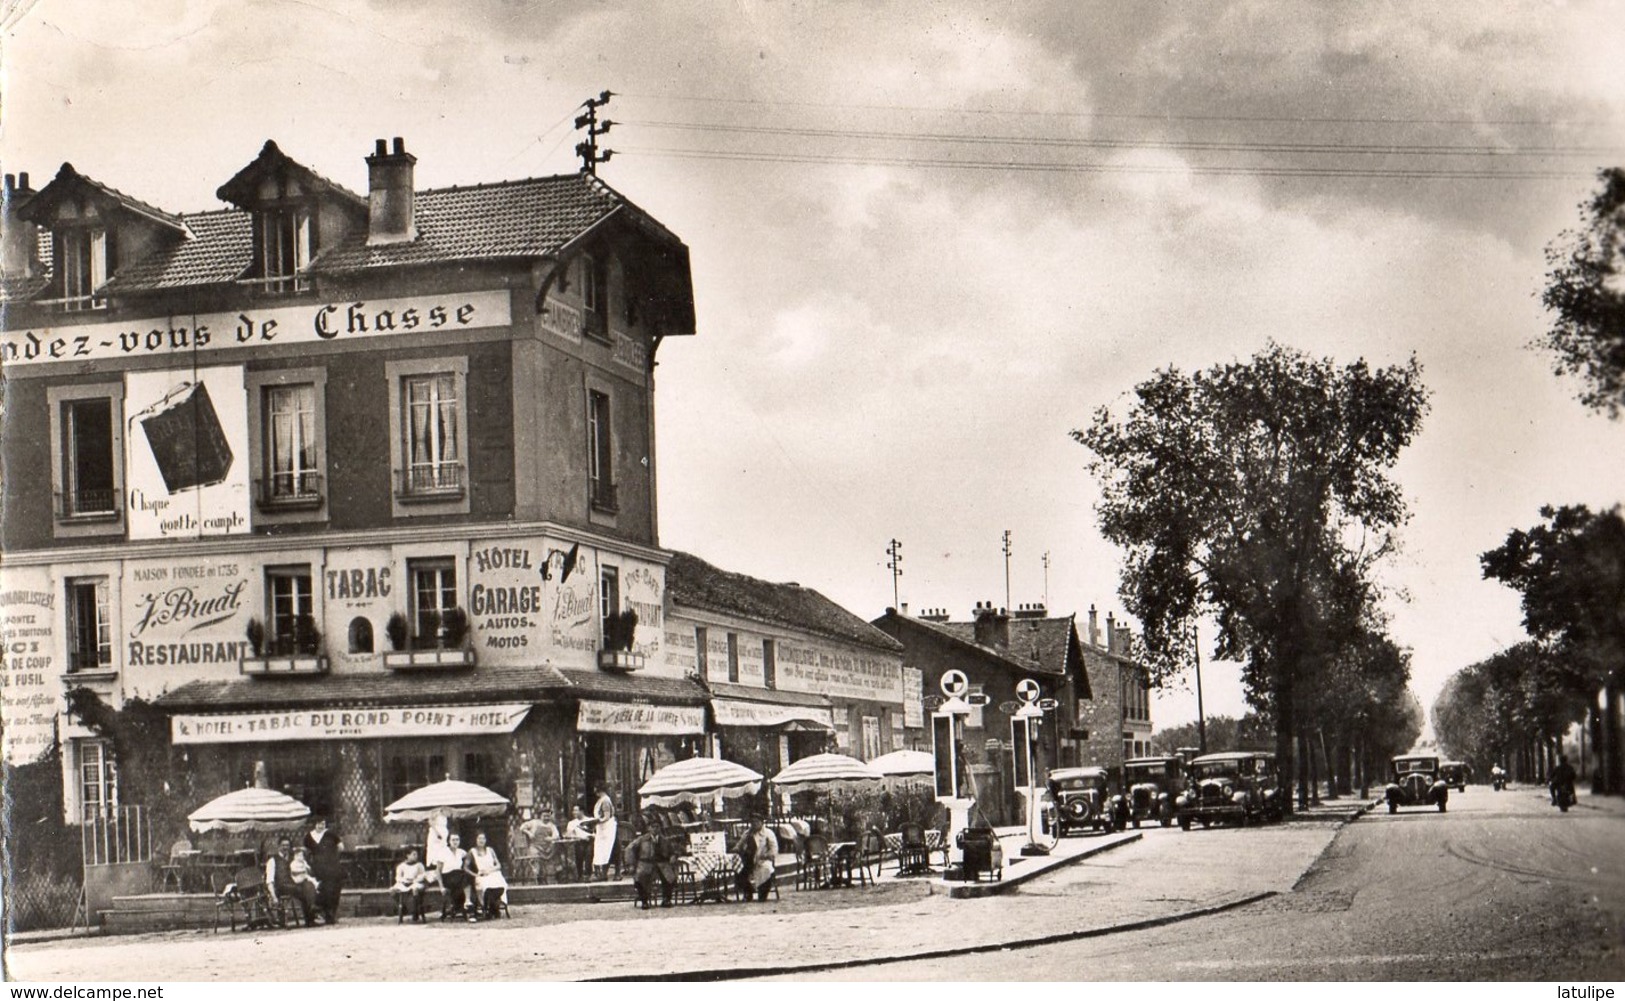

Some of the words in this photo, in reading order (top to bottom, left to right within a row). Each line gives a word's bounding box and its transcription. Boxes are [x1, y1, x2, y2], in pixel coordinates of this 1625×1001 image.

[236, 314, 278, 343] de
[315, 301, 476, 339] Chasse
[131, 488, 169, 516] Chaque
[160, 514, 198, 535] goutte
[203, 511, 244, 533] compte
[476, 546, 532, 572] HÔTEL
[134, 568, 168, 581] MAISON
[327, 566, 391, 599] TABAC
[472, 584, 540, 616] GARAGE
[485, 617, 528, 630] AUTOS
[128, 641, 248, 666] RESTAURANT
[486, 635, 528, 648] MOTOS
[12, 657, 23, 670] DE
[26, 656, 52, 669] COUP
[15, 673, 45, 686] FUSIL
[196, 721, 234, 735] HOTEL
[248, 715, 303, 732] TABAC
[311, 713, 335, 727] DU
[341, 711, 390, 726] ROND
[402, 711, 455, 727] POINT
[470, 712, 510, 726] HOTEL
